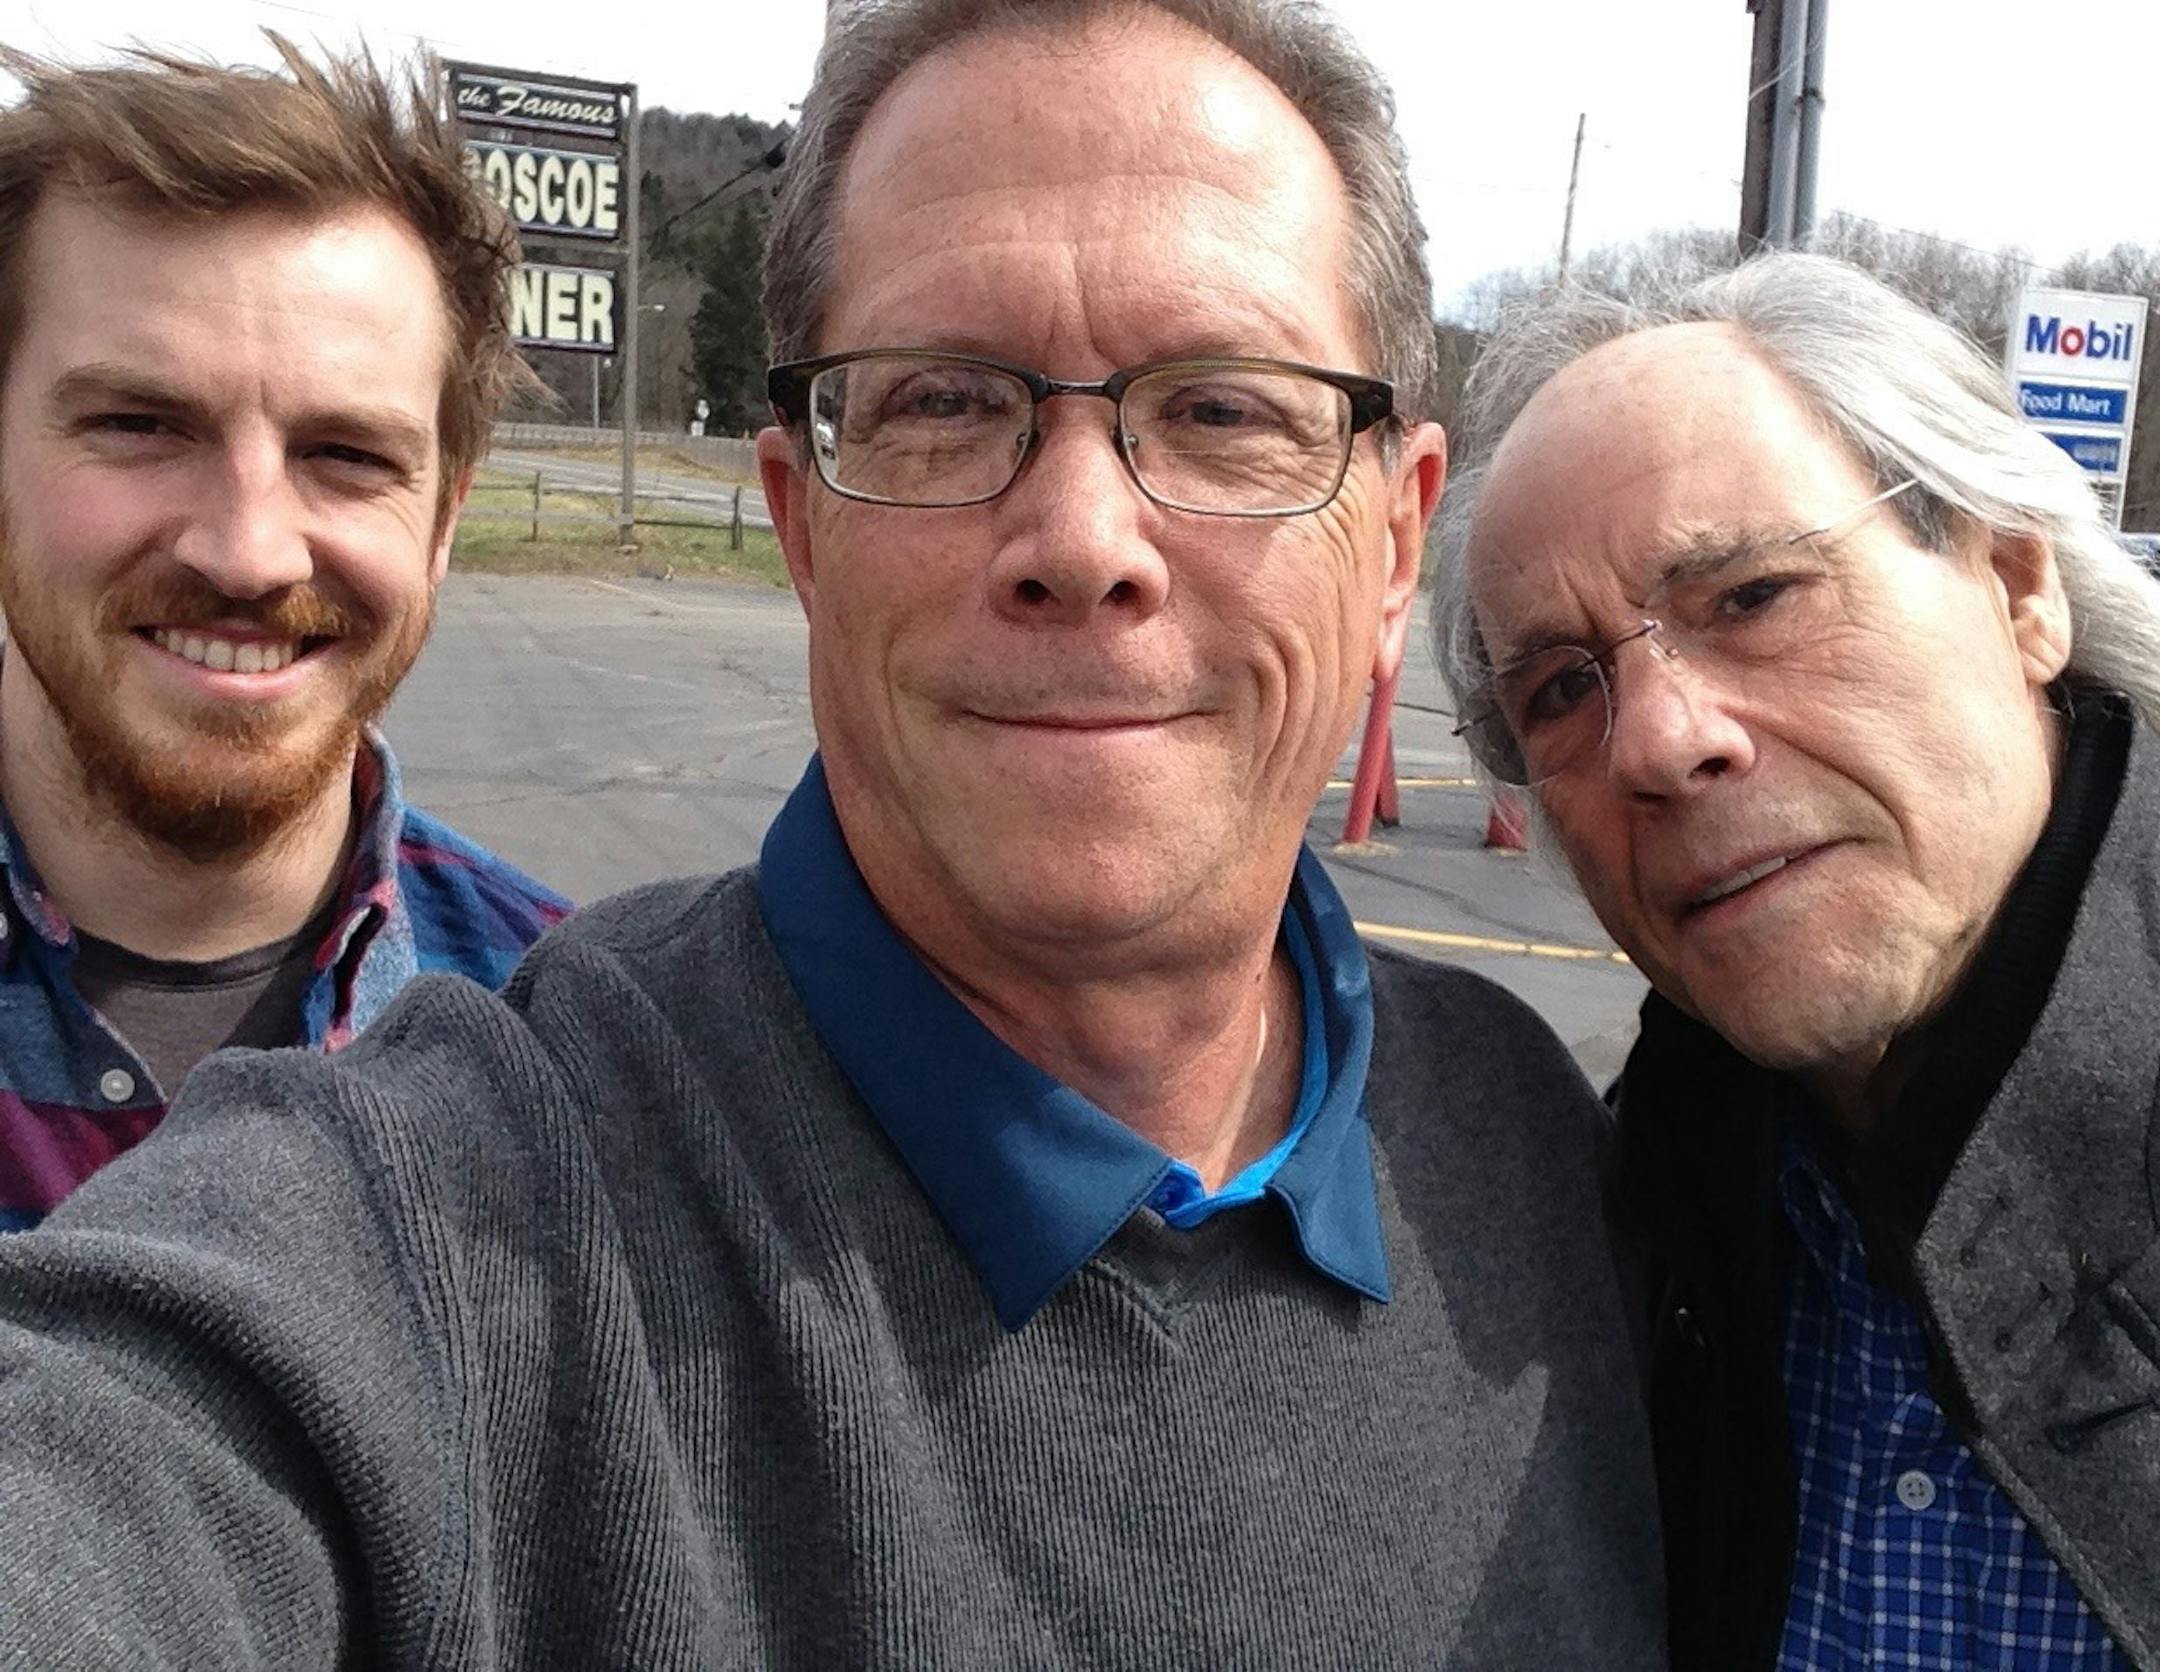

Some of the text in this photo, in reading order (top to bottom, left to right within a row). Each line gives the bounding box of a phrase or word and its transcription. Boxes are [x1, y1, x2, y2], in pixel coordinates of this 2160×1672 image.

[457, 85, 618, 123] the Famous
[510, 269, 614, 345] NER
[2025, 314, 2133, 361] Mobil
[2021, 389, 2112, 416] Food Mart
